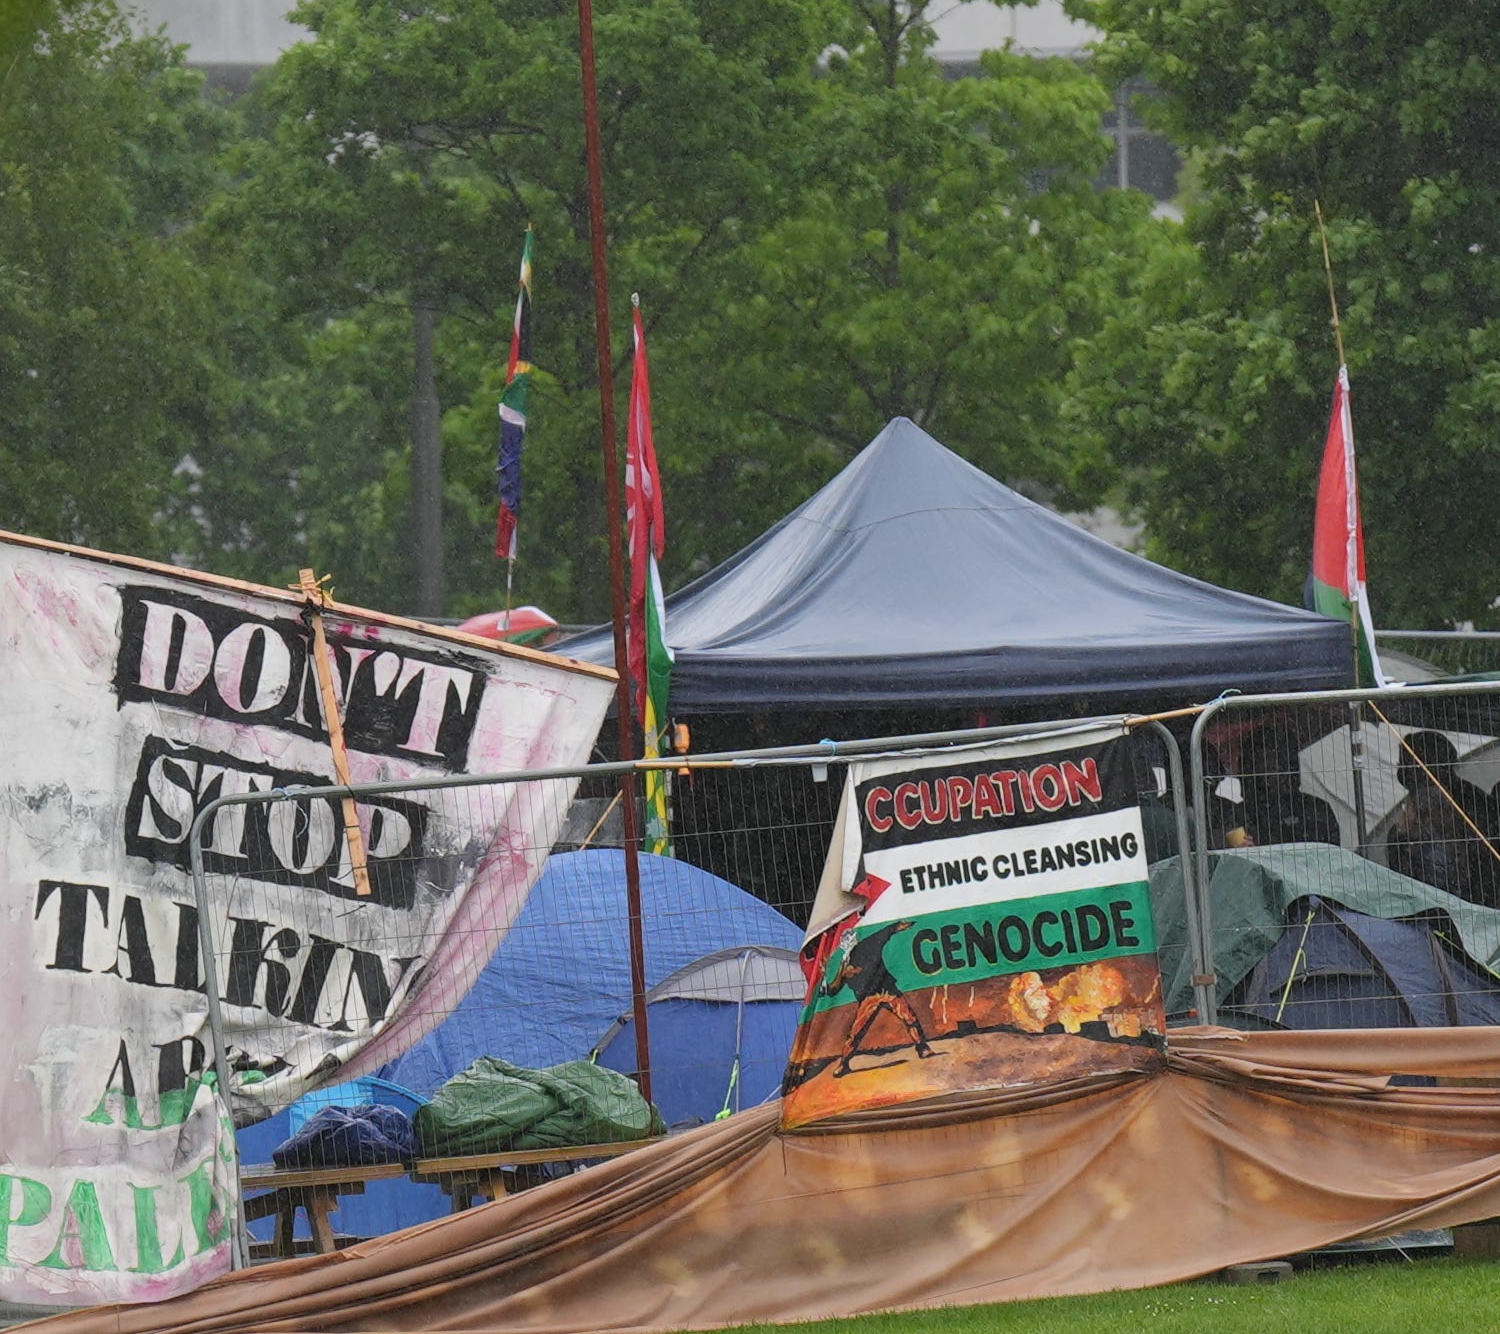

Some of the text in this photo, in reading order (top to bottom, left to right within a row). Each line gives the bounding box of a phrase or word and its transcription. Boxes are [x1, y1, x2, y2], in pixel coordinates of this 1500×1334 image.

[137, 599, 474, 758] DON'T
[137, 754, 412, 886] STOP
[865, 757, 1103, 834] CCUPATION
[899, 832, 1138, 894] ETHNIC CLEANSING
[34, 880, 425, 1032] TALKIN
[912, 900, 1140, 975] GENOCIDE
